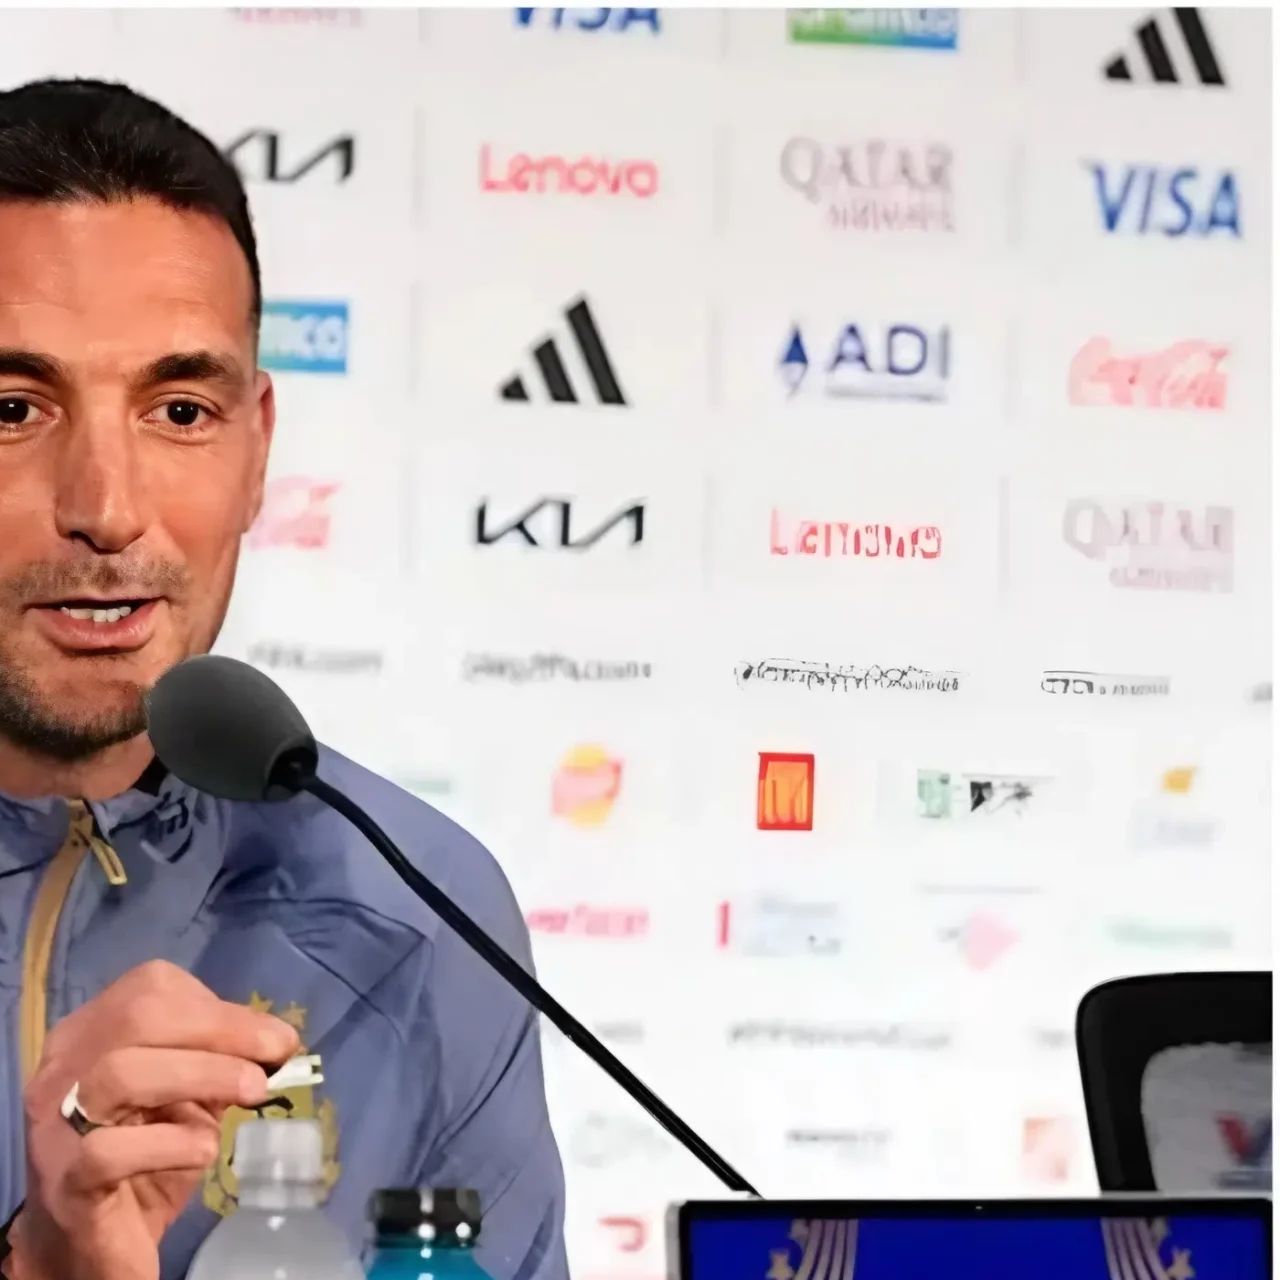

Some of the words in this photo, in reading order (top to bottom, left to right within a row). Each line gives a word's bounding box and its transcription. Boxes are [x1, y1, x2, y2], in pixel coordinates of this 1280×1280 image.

[480, 143, 659, 197] Lenovo
[1082, 160, 1242, 239] VISA
[829, 322, 951, 380] ADI
